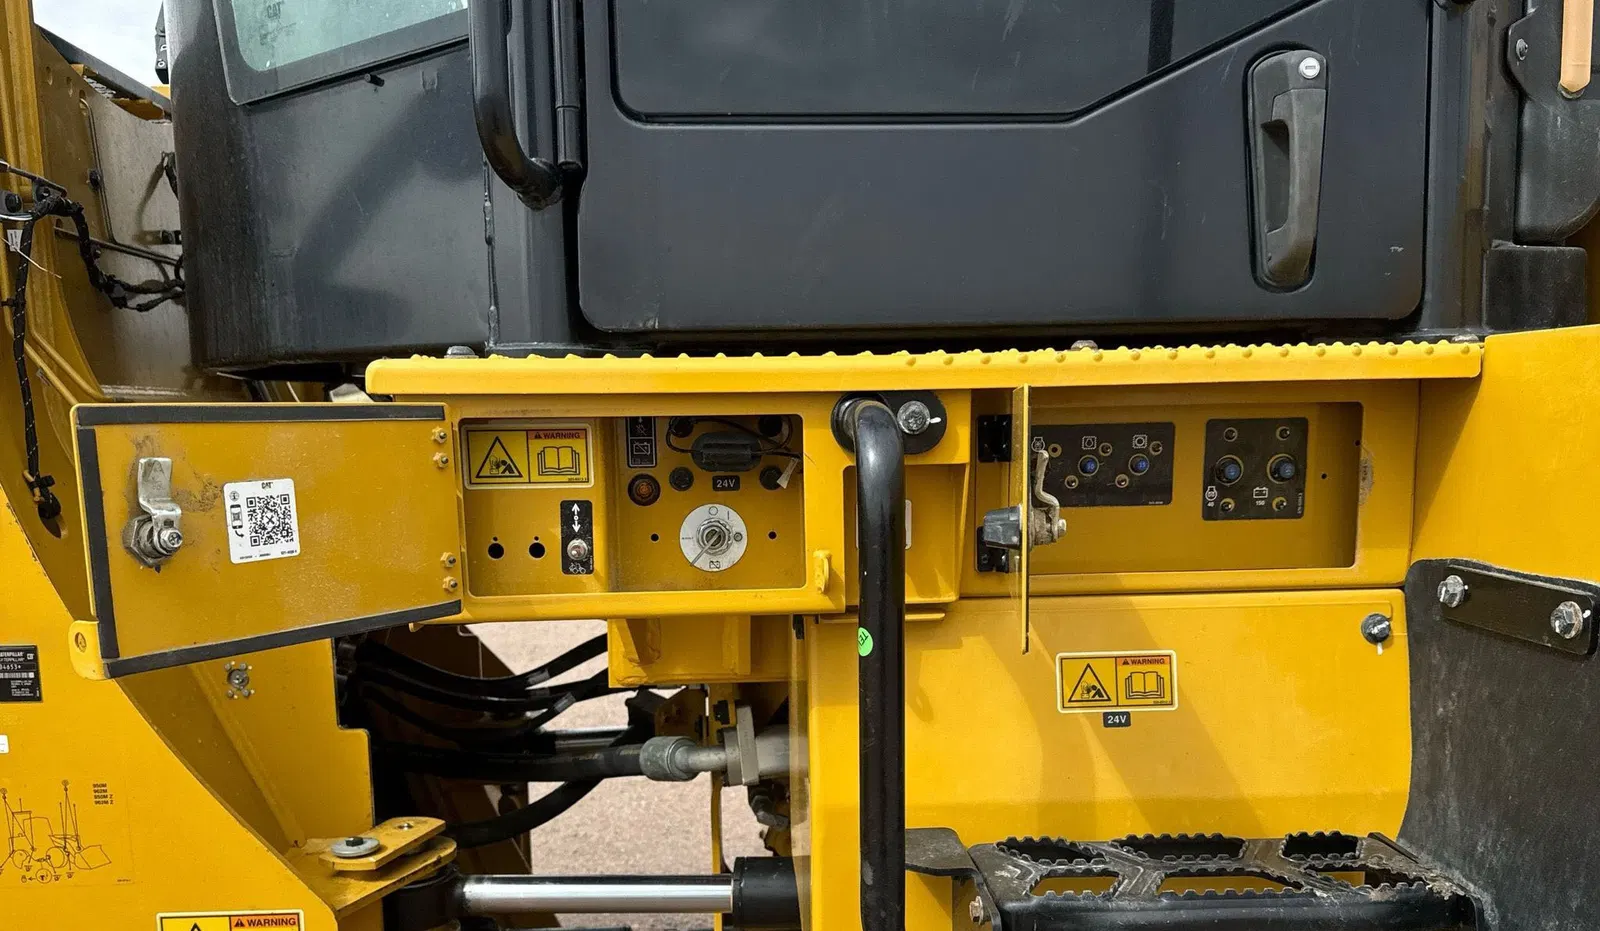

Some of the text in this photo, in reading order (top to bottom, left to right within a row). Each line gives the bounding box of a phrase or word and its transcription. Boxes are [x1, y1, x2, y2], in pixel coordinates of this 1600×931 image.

[266, 2, 281, 19] CAT
[716, 479, 736, 488] 24V
[1107, 715, 1127, 724] 24V
[247, 918, 296, 927] WARNING
